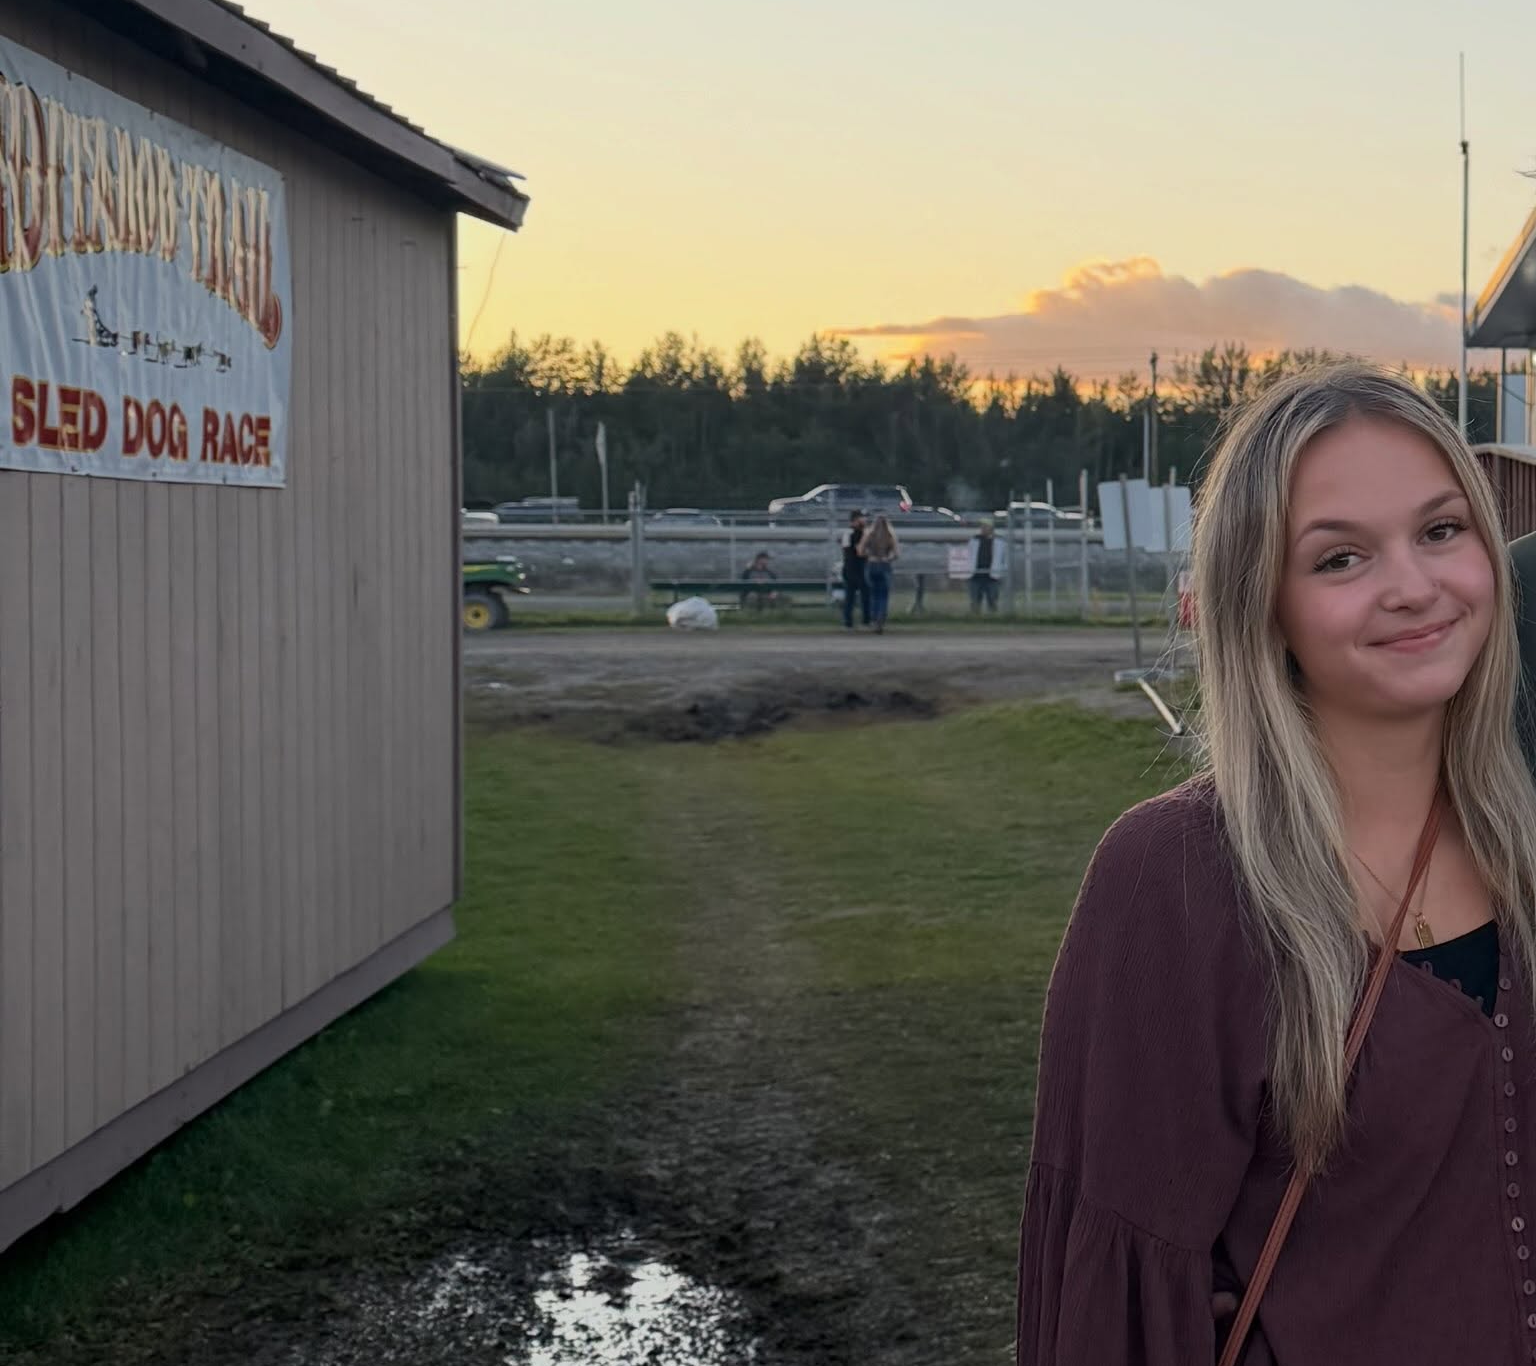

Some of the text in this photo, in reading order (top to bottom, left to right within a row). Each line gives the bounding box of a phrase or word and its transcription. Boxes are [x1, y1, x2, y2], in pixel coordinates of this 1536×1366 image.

[11, 373, 272, 469] SLED DOG RACE
